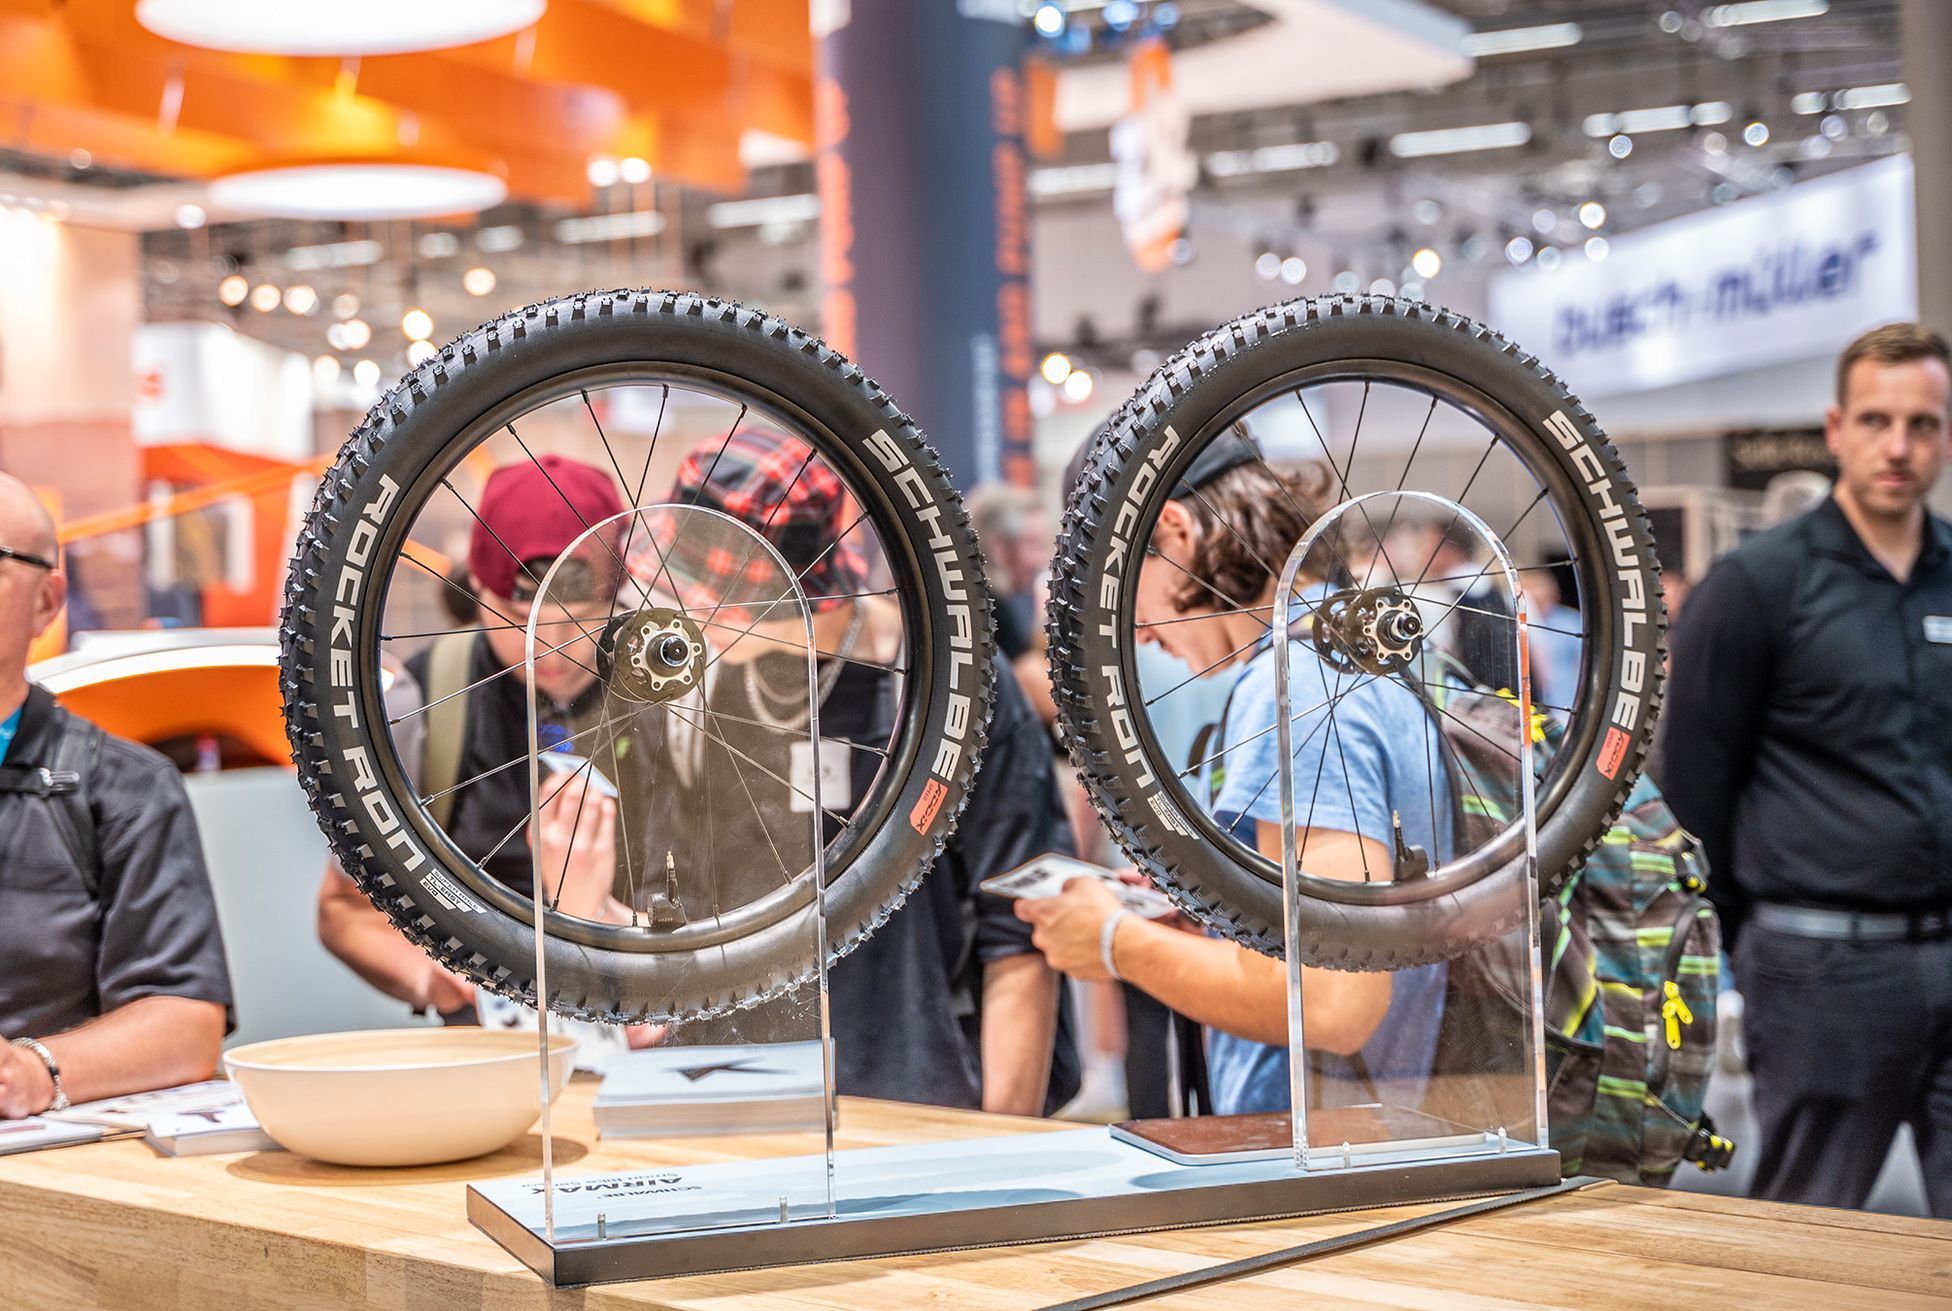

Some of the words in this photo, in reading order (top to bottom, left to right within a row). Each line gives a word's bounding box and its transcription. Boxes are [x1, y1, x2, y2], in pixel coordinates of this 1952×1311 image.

[330, 473, 400, 729] ROCKET
[862, 428, 973, 782] SCHWALBE
[1099, 425, 1181, 649] ROCKET
[1542, 409, 1647, 731] SCHWALBE
[343, 745, 426, 872] RON
[1101, 665, 1156, 789] RON
[423, 881, 439, 897] EVO
[429, 875, 461, 904] TL-EASY
